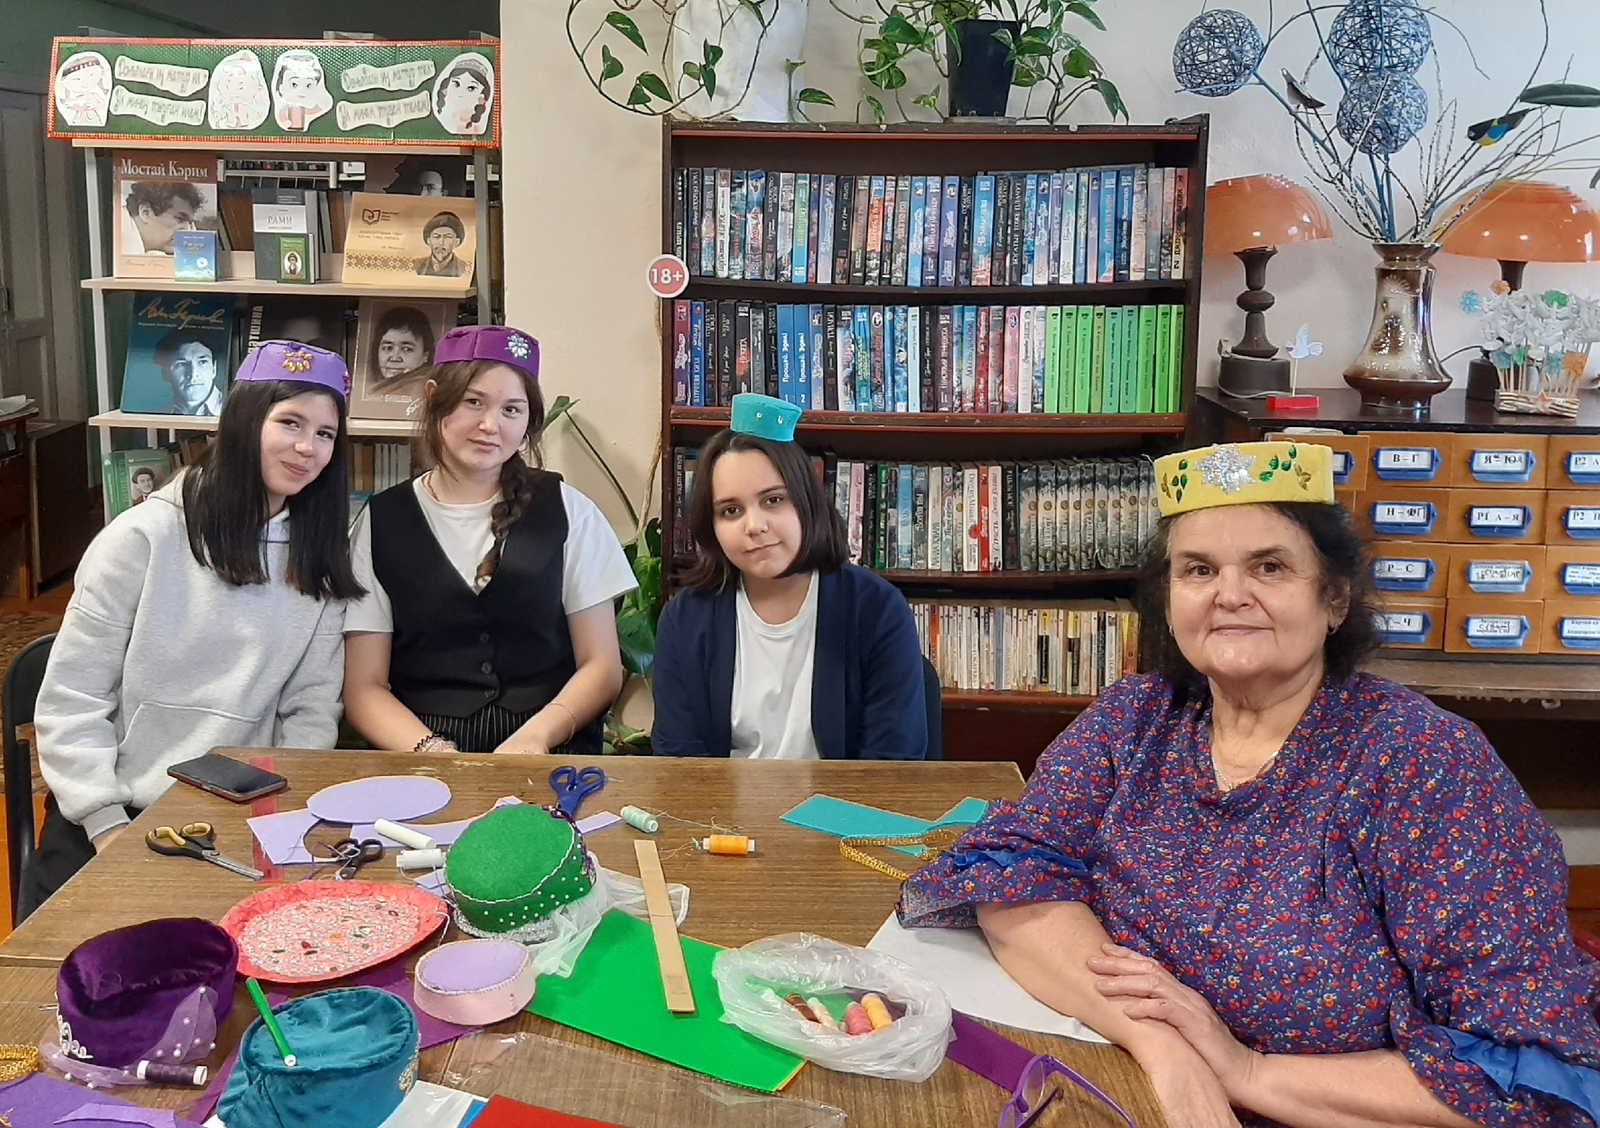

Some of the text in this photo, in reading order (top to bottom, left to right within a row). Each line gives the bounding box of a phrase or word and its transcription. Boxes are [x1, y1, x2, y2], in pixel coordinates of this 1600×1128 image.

[120, 158, 209, 180] Мостай Кәрим
[267, 215, 293, 224] РАМИ
[651, 268, 684, 284] 18+
[1393, 453, 1400, 463] В
[1412, 453, 1420, 463] Г
[1574, 456, 1587, 466] Р2
[1386, 507, 1395, 516] Н
[1572, 511, 1585, 521] Р2
[1387, 563, 1395, 573] Р
[1405, 563, 1415, 573] С
